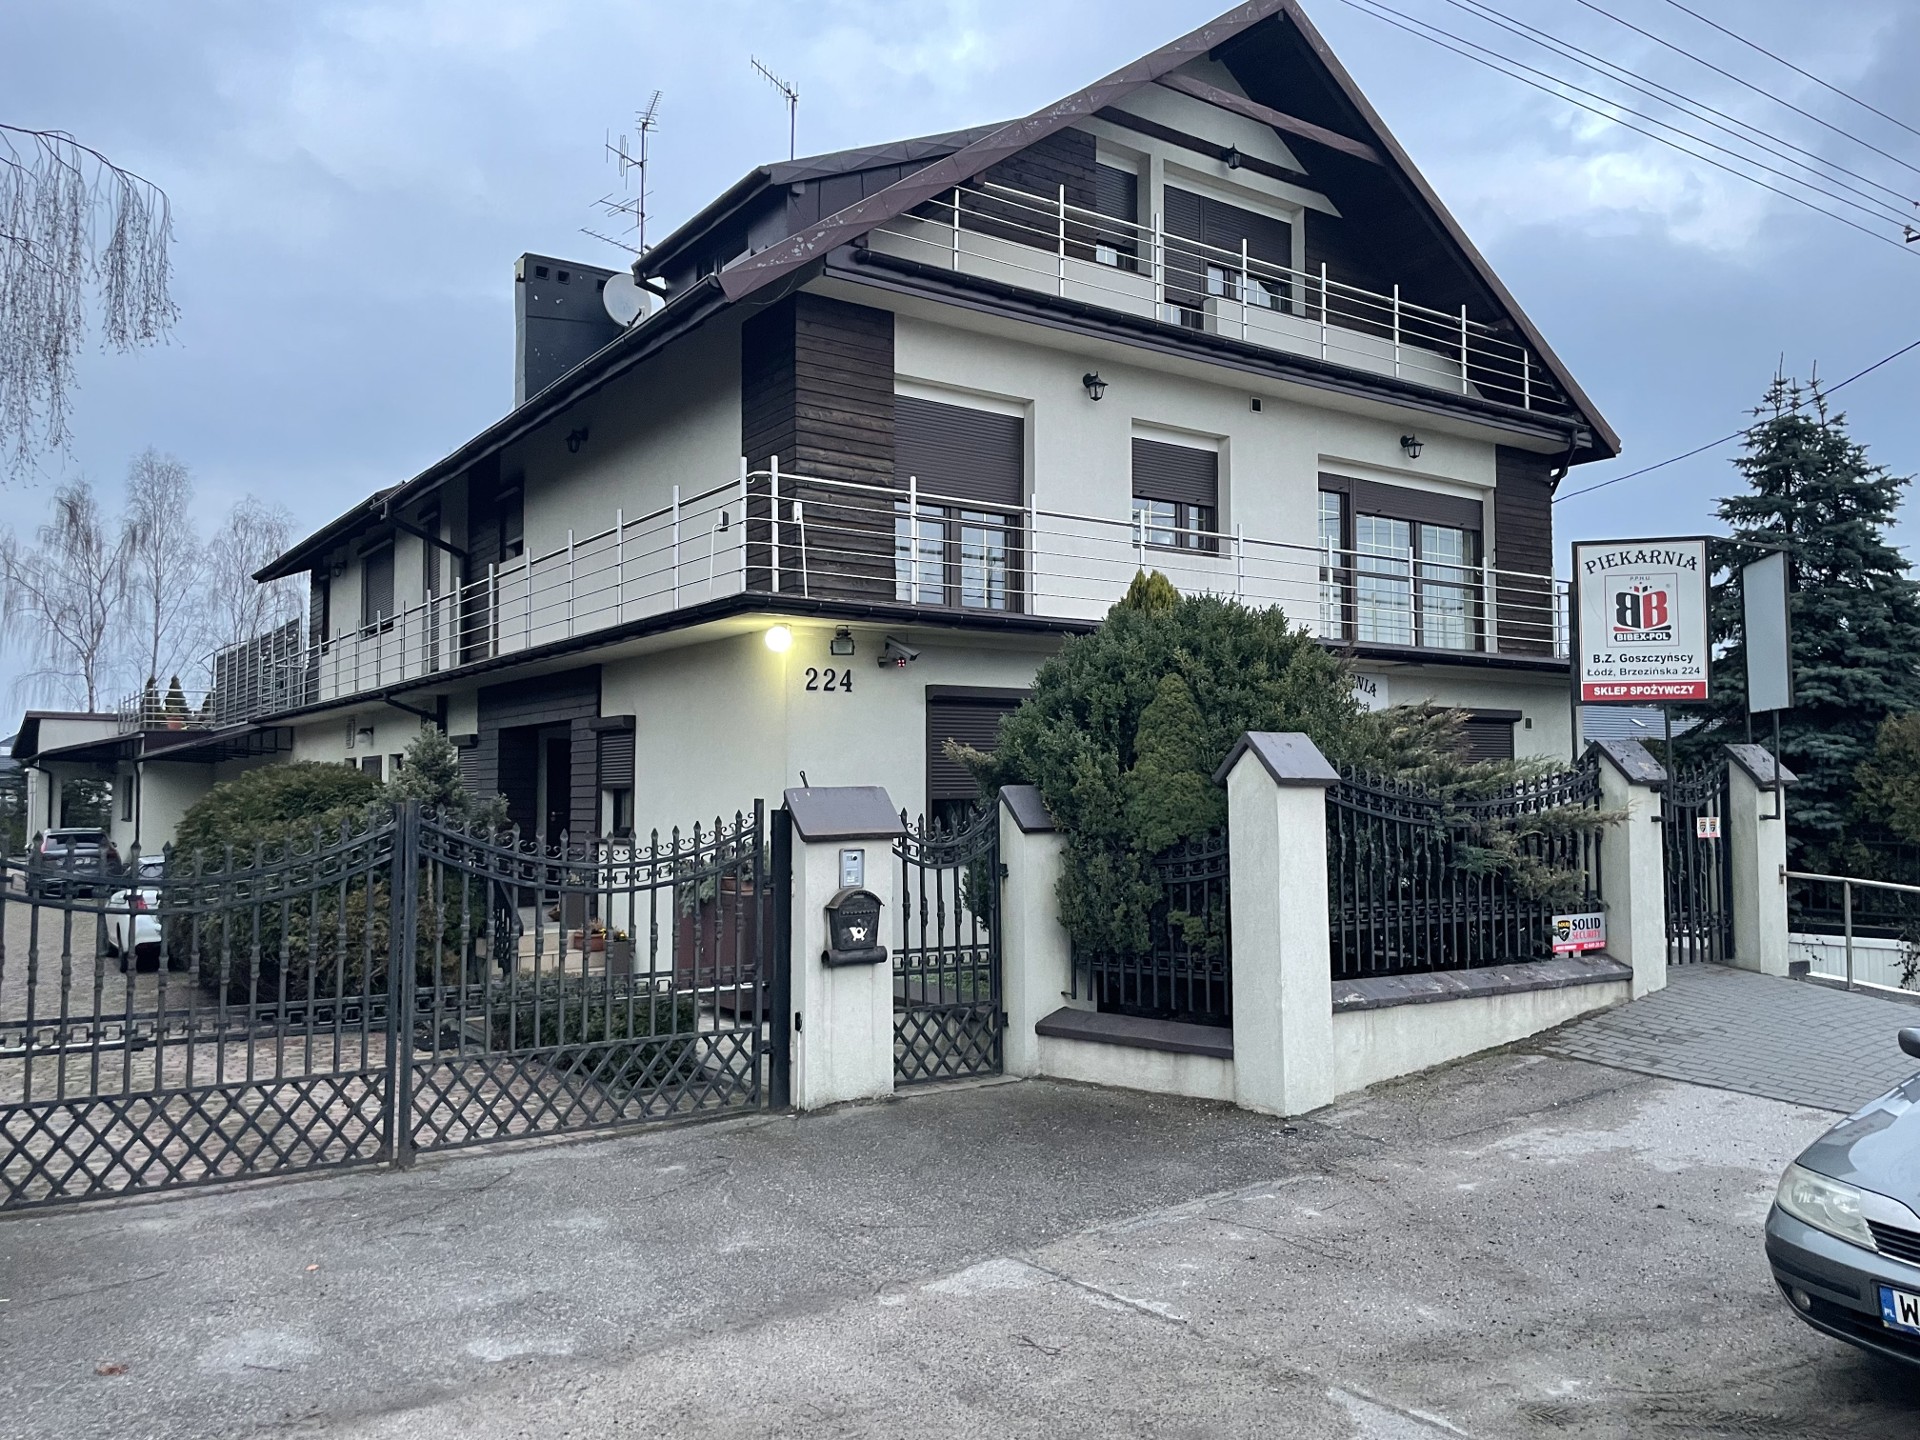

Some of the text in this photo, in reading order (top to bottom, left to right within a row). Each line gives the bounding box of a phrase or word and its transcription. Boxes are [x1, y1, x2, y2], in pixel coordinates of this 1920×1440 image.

[1584, 549, 1698, 575] PIEKARNIA
[1616, 632, 1669, 641] BIBEX-POL
[1593, 651, 1694, 665] B.Z. Goszczyńscy
[1587, 666, 1701, 677] Łódź, Brzezińska 224
[805, 667, 853, 692] 224
[1593, 684, 1695, 696] SKLEP SPOŻYWCZY
[1572, 917, 1601, 931] SOLID
